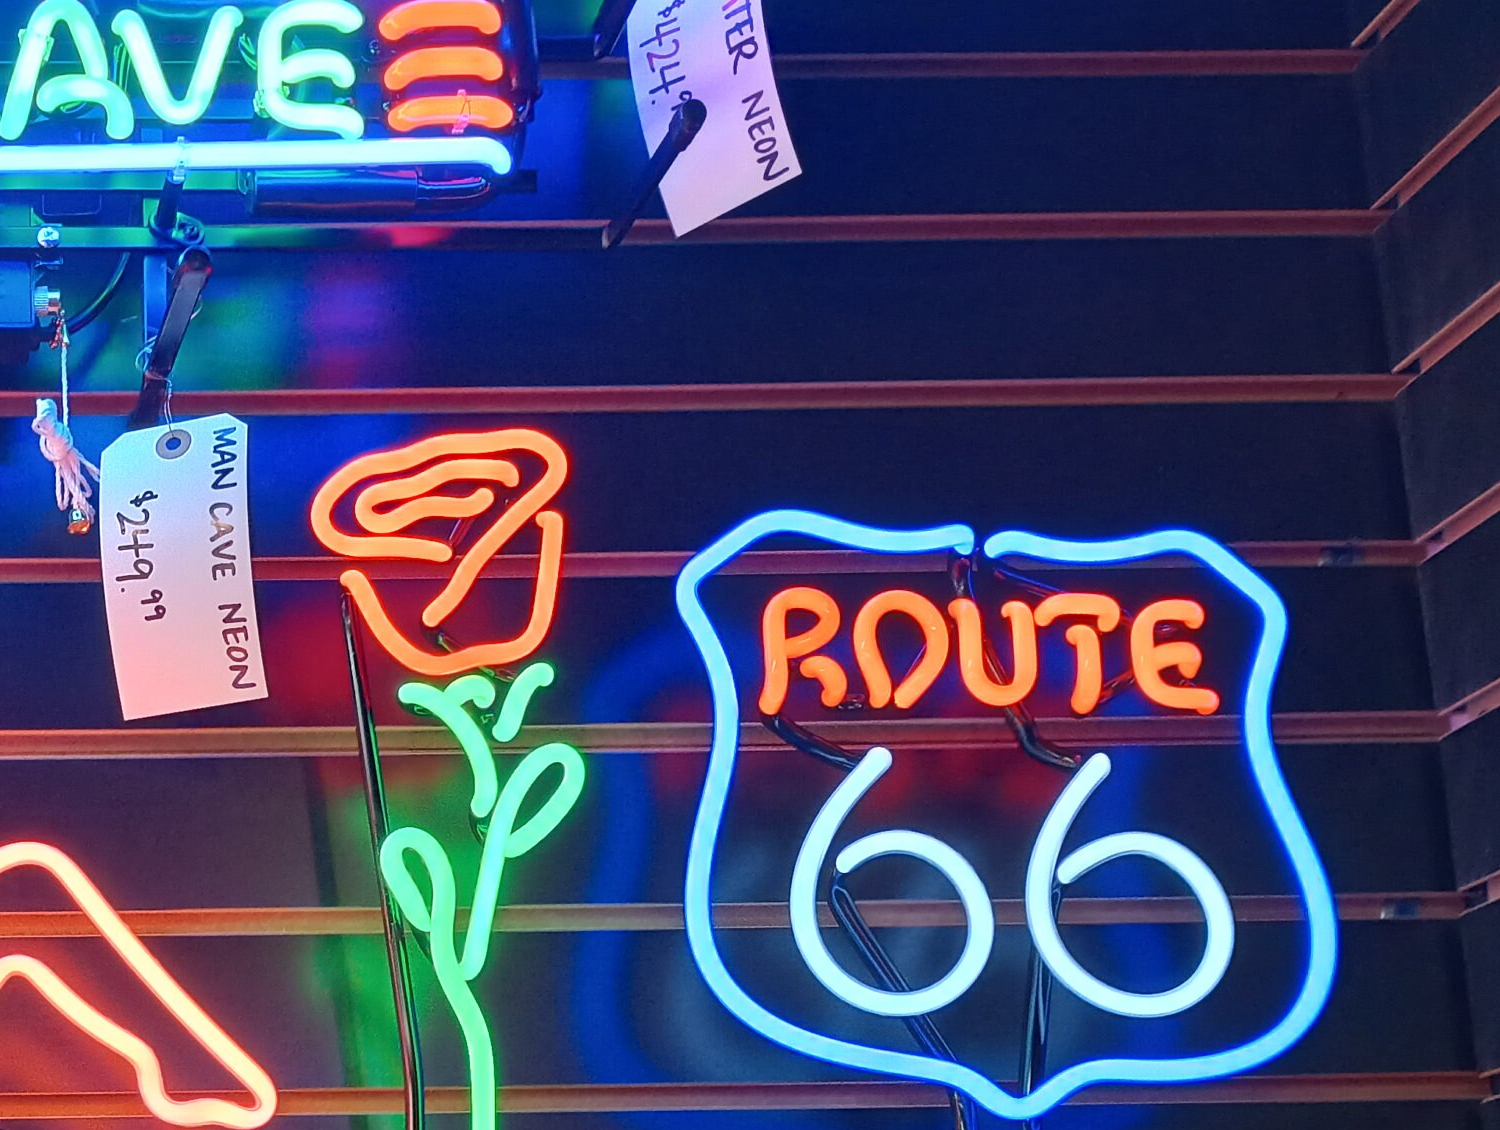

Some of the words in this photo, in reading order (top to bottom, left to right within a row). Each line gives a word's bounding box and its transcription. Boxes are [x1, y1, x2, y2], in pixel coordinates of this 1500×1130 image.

[722, 0, 759, 76] TER
[741, 90, 790, 182] NEON
[211, 426, 238, 490] MAN
[115, 490, 167, 621] $249.99
[209, 502, 237, 581] CAVE
[218, 603, 257, 690] NEON
[759, 585, 1220, 717] ROUTE
[790, 746, 1235, 1017] 66
